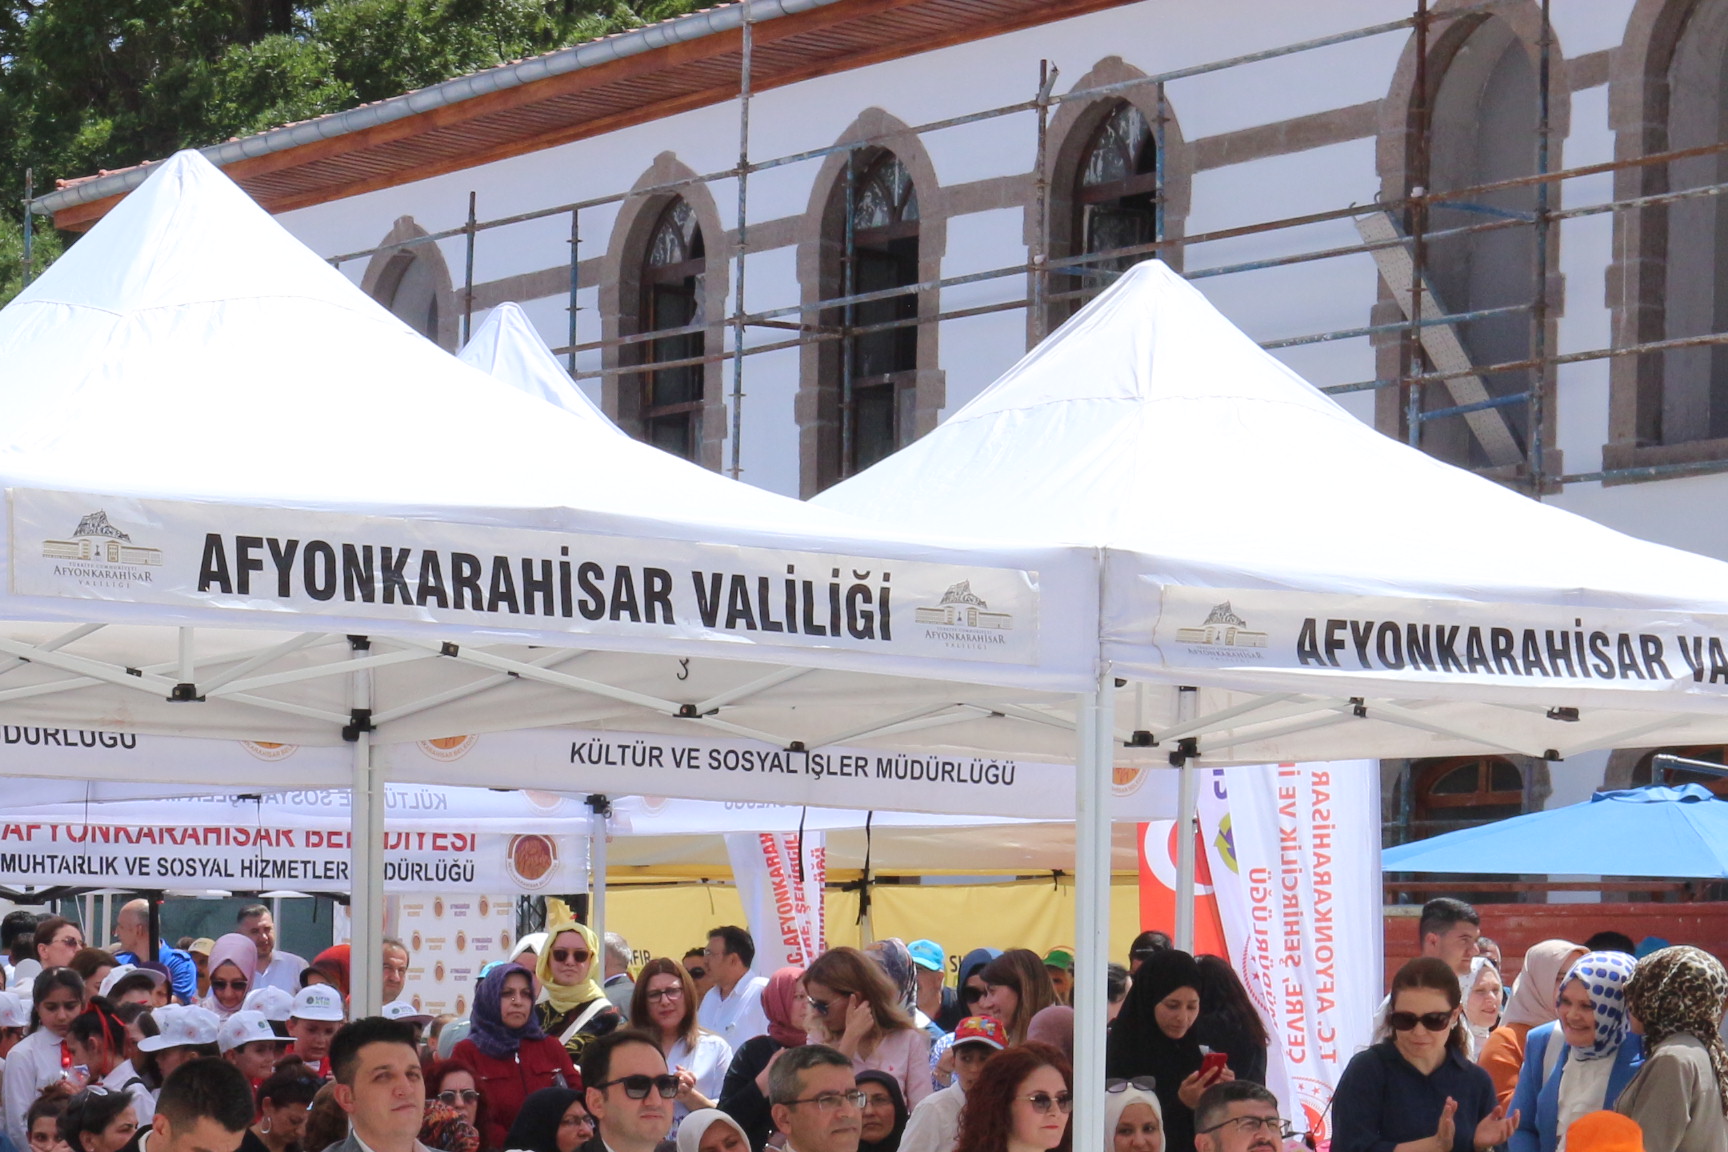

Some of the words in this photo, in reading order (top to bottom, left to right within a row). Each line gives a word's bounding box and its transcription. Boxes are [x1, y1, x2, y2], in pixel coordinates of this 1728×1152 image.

[197, 533, 675, 625] AFYONKARAHİSAR
[692, 564, 892, 641] VALİLİĞİ
[1297, 617, 1672, 680] AFYONKARAHİSAR
[571, 738, 663, 769] KÜLTÜR
[672, 746, 701, 770] VE
[708, 747, 799, 774] SOSYAL
[876, 756, 1016, 786] MÜDÜRLÜĞÜ
[1, 853, 119, 876] MUHTARLIK
[126, 857, 150, 876] VE
[157, 857, 235, 878] SOSYAL
[240, 858, 350, 881] HİZMETLER
